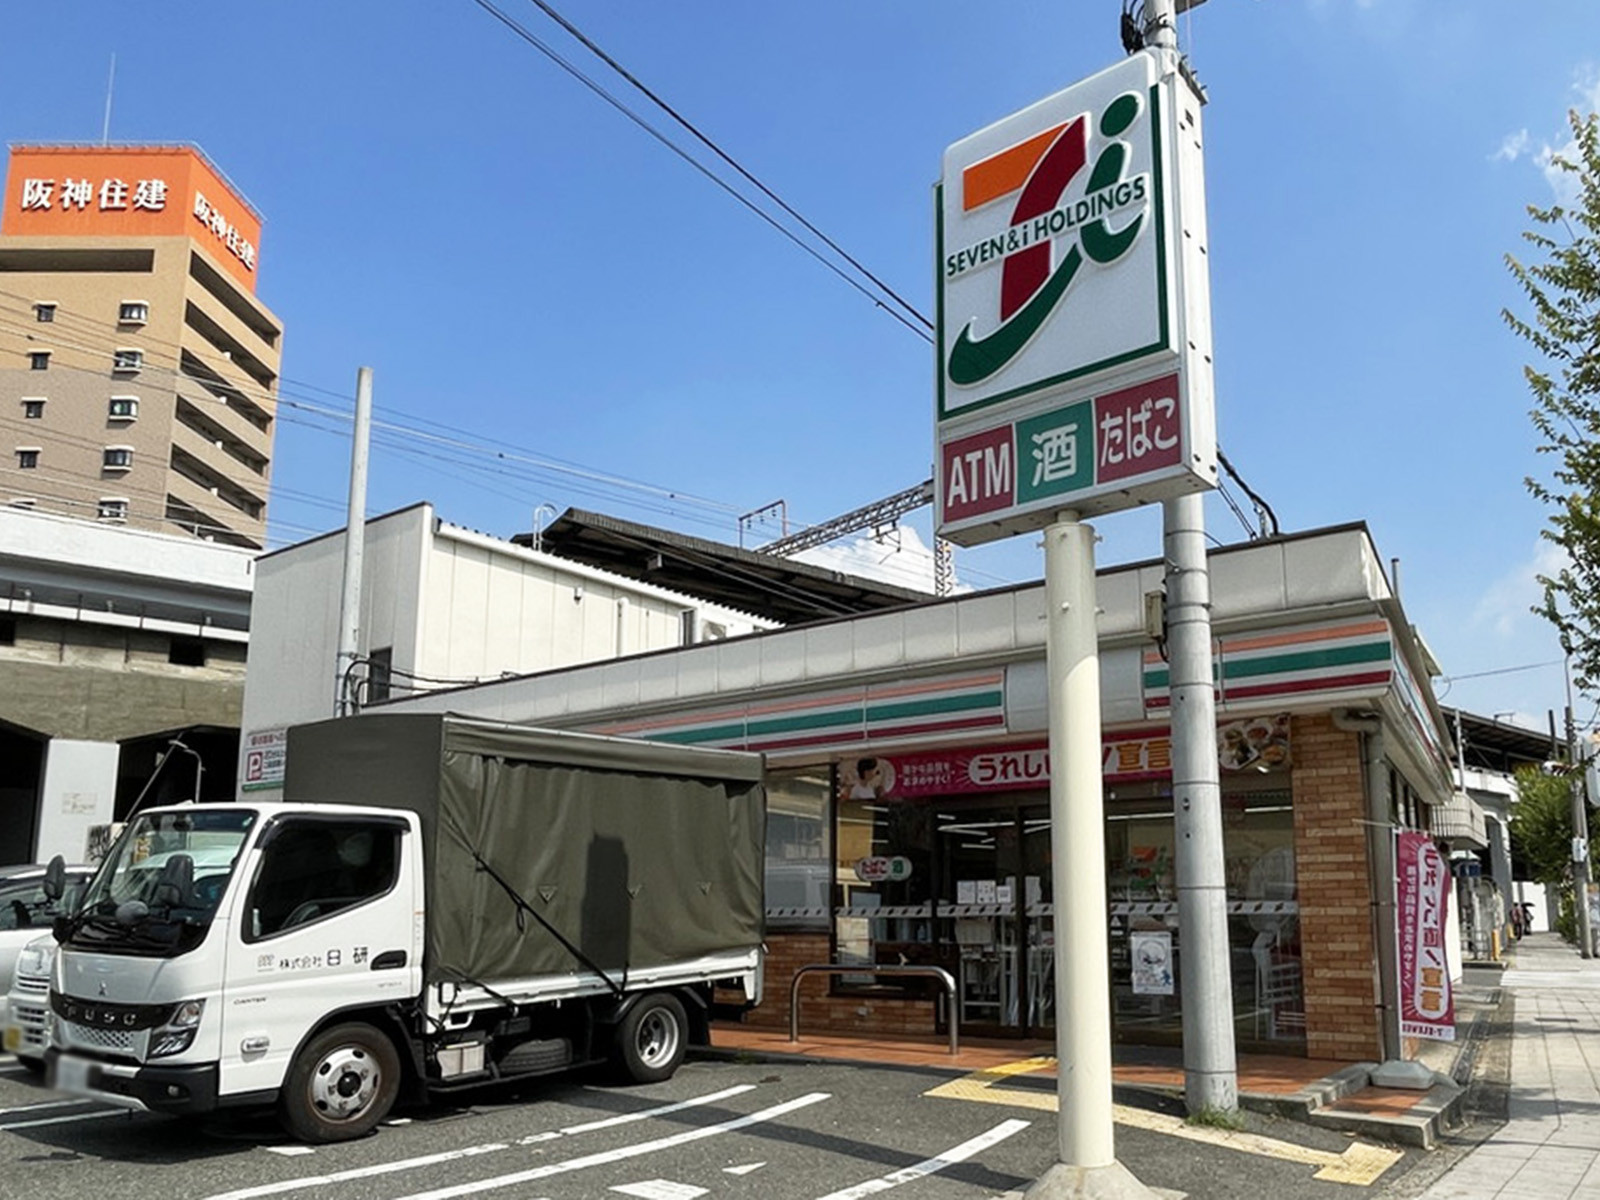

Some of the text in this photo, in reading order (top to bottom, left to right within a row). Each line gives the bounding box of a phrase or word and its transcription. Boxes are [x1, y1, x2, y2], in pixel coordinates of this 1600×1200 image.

[21, 178, 168, 210] 阪神住建
[1034, 175, 1146, 241] HOLDINGS
[193, 191, 257, 270] 阪神住建
[1031, 422, 1078, 487] 酒
[1100, 397, 1178, 467] たばこ
[947, 442, 1011, 507] ATM
